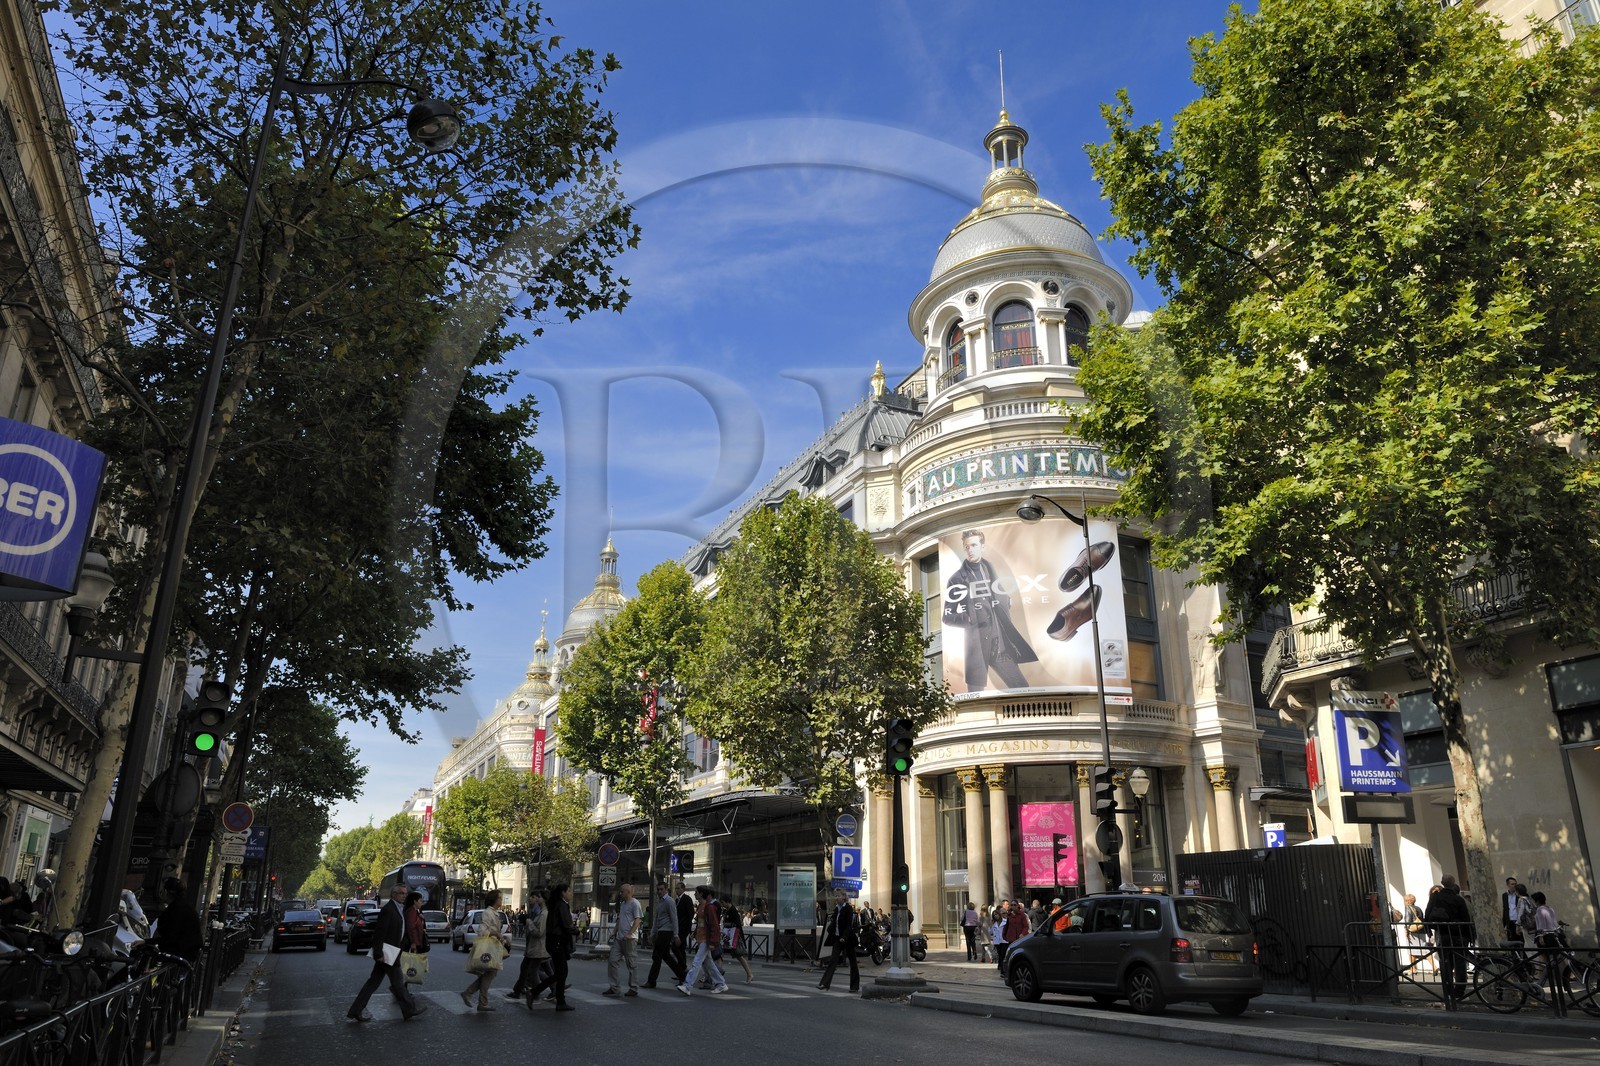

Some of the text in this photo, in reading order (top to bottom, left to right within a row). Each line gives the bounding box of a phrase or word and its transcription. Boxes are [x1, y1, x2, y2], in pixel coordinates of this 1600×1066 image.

[927, 468, 956, 495] AU
[944, 574, 1049, 603] GEOX
[966, 739, 1049, 755] MAGASINS
[1070, 739, 1092, 750] DU
[1112, 740, 1183, 755] PRINTEMPS
[1344, 716, 1380, 766] P
[1350, 769, 1403, 778] HAUSSMANN
[1352, 778, 1397, 786] PRINTEMPS
[1266, 832, 1278, 848] P
[841, 852, 854, 872] P
[1152, 873, 1167, 882] 20H
